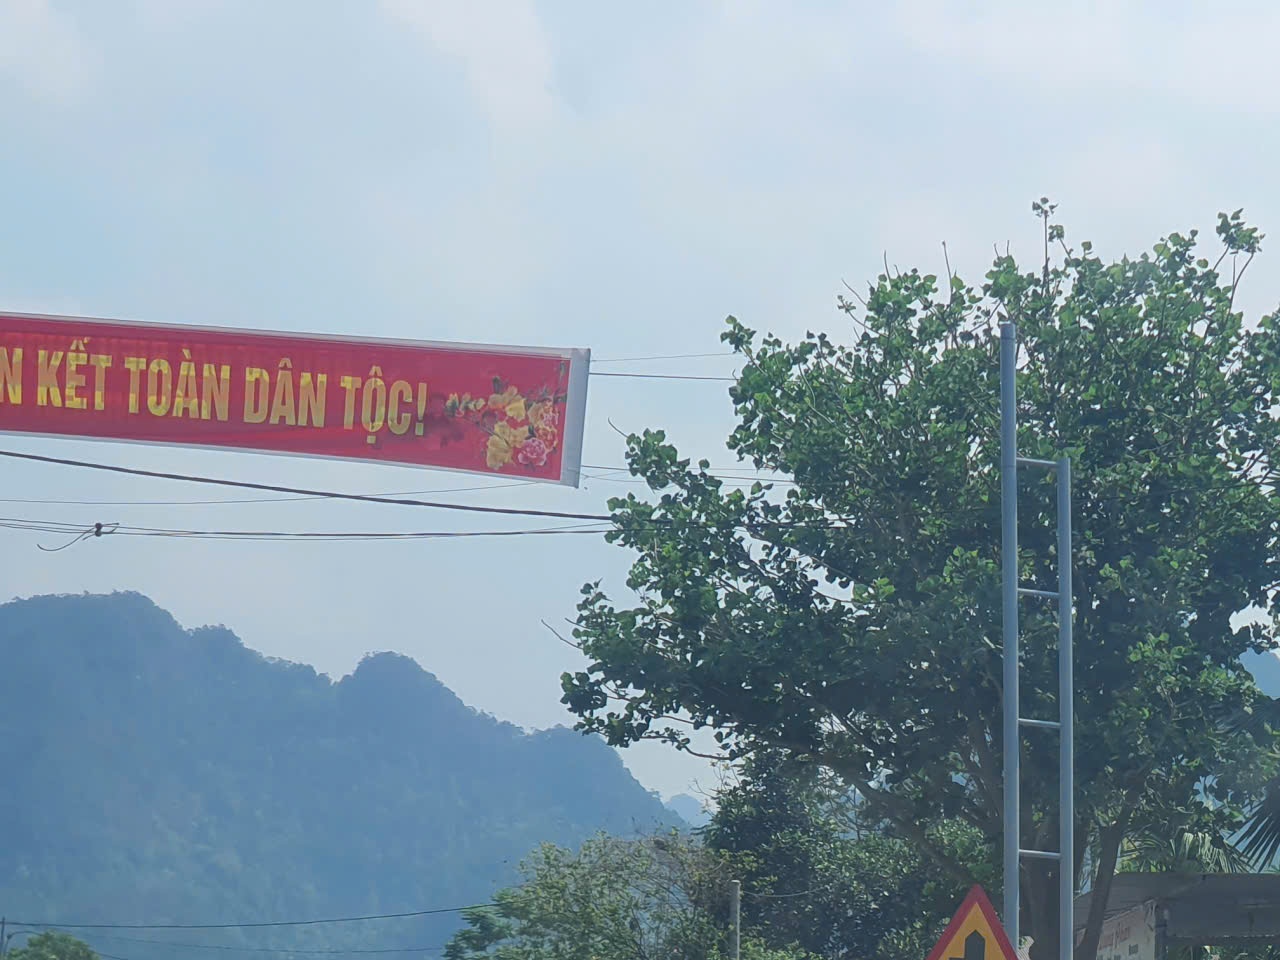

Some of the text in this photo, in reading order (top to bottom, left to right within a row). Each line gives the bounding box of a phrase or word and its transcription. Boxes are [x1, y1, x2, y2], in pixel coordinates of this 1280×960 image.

[37, 337, 112, 410] KẾT
[124, 349, 230, 421] TOÀN
[243, 357, 328, 428] DÂN
[340, 365, 428, 444] TỘC!
